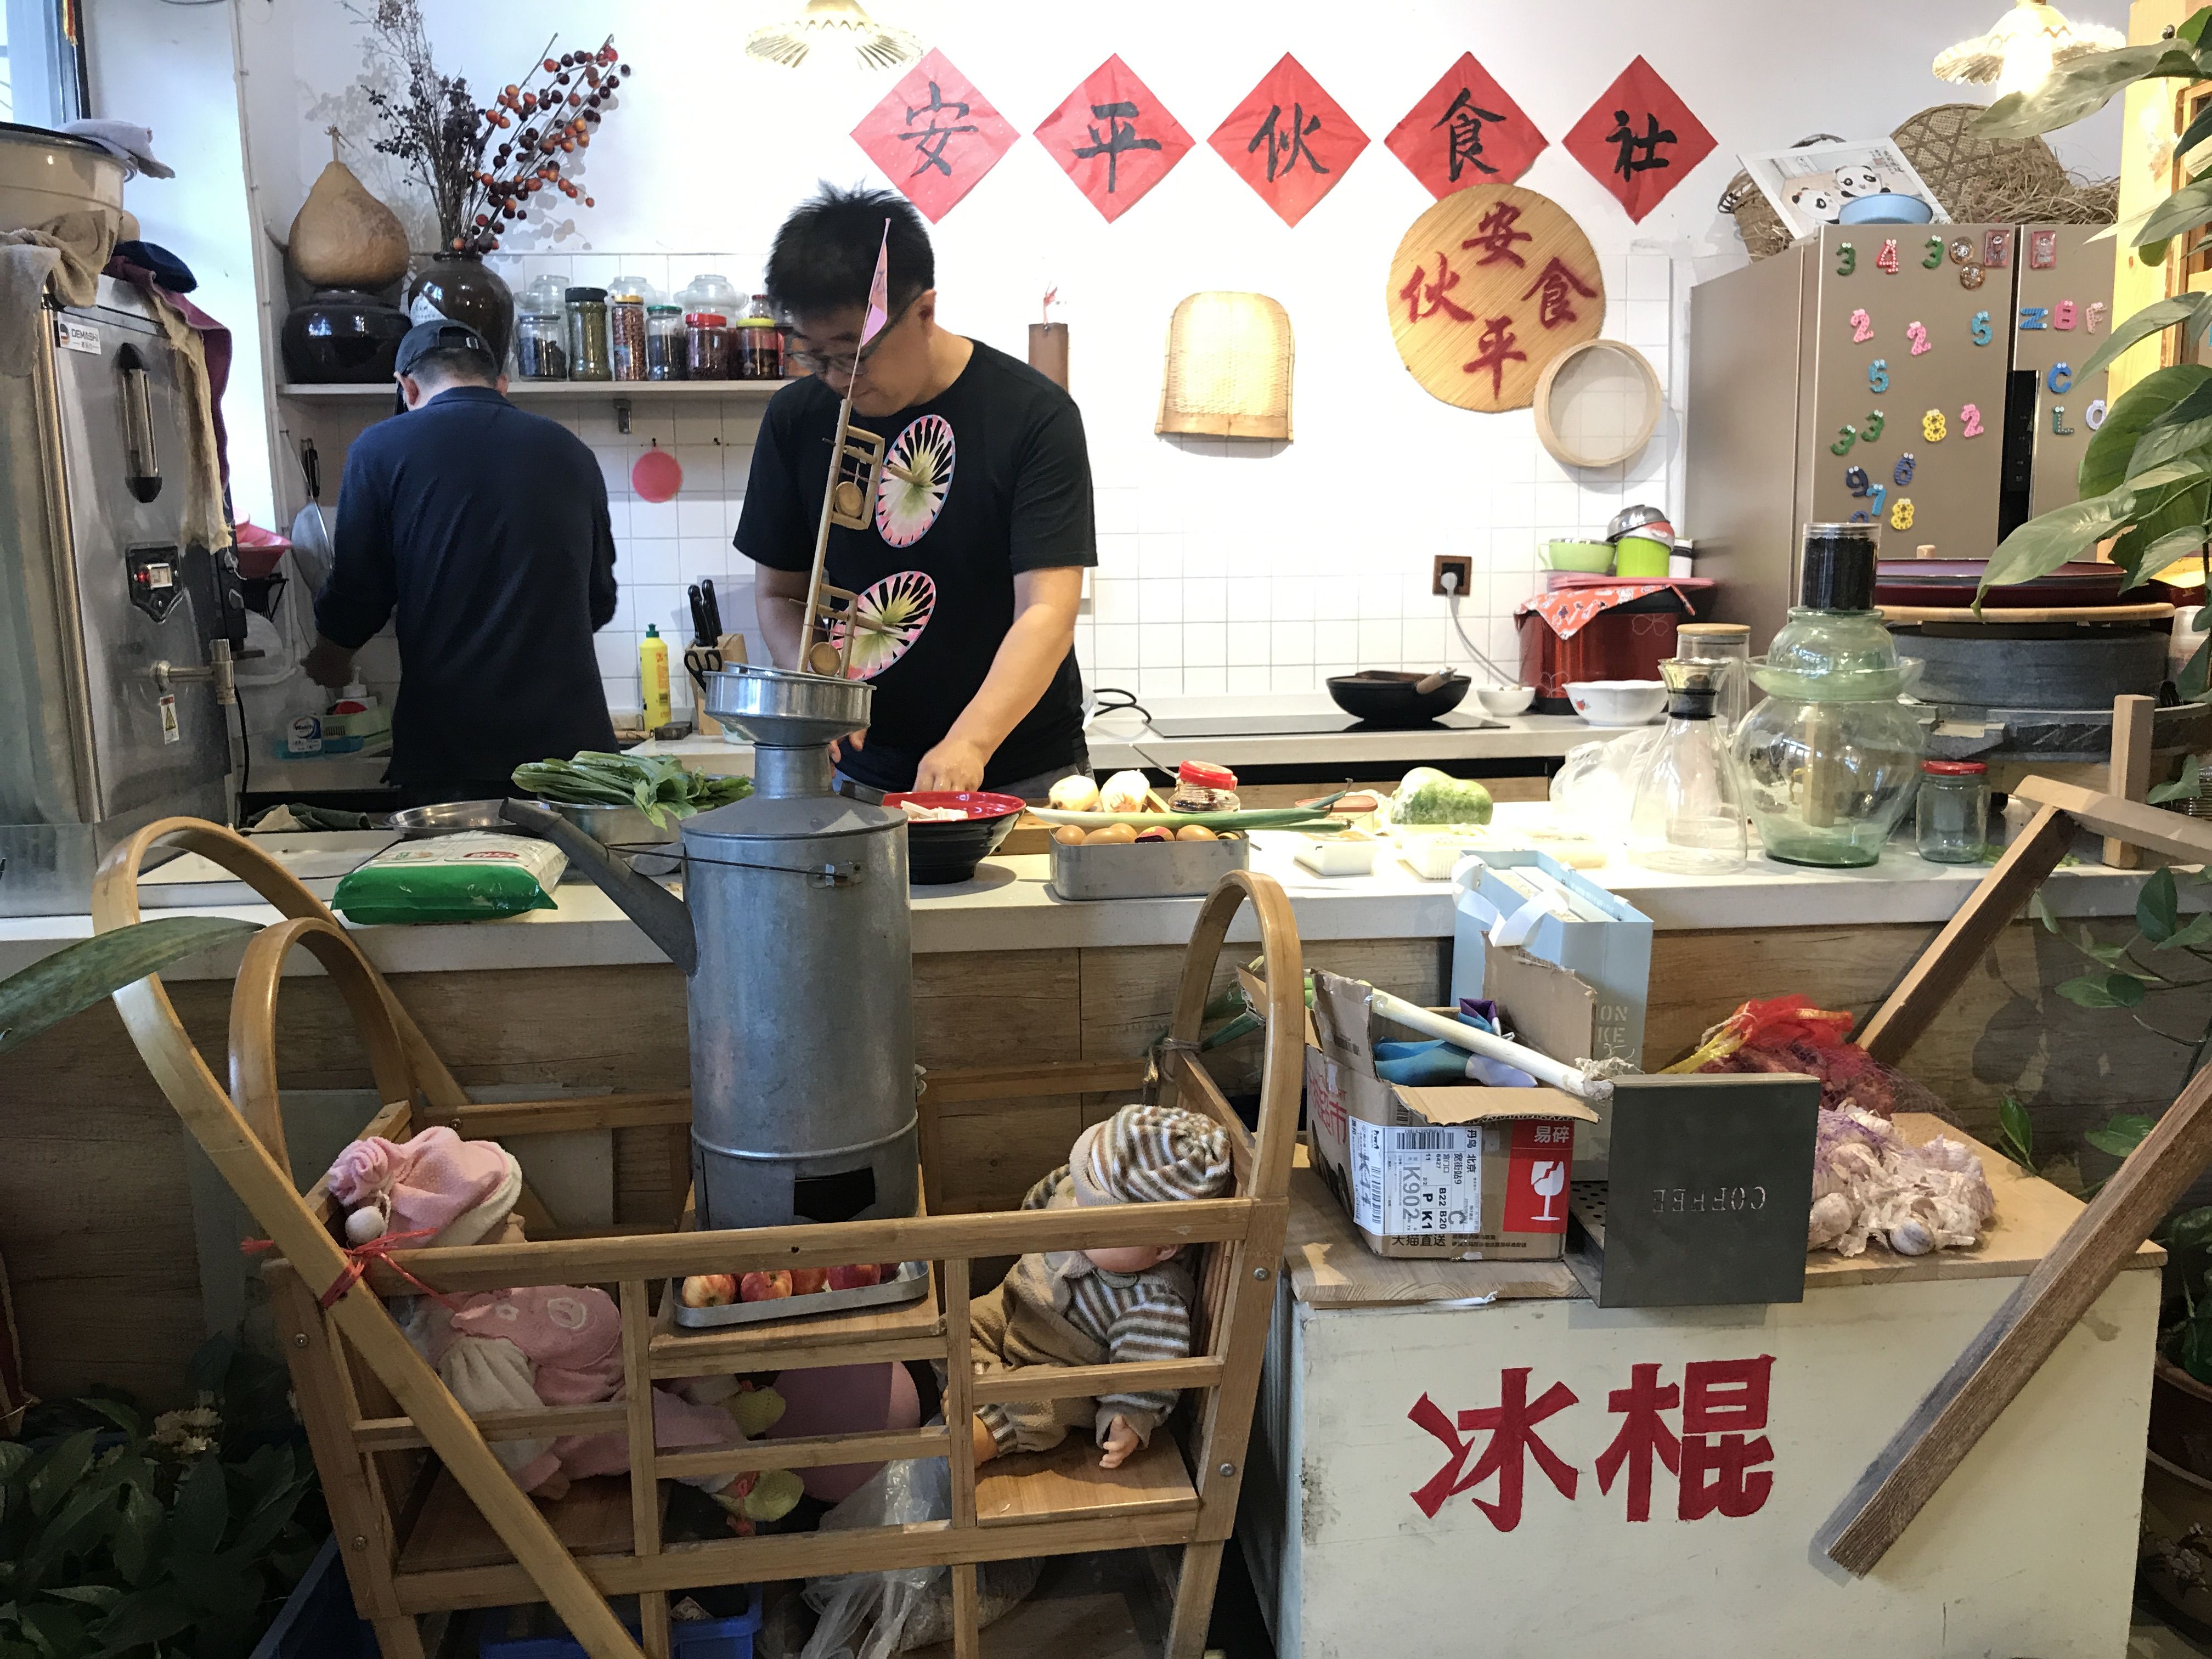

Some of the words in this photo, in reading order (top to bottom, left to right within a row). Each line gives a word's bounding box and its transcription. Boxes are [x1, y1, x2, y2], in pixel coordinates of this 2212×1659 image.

[1837, 242, 1856, 275] 3
[1876, 239, 1899, 274] 4
[1922, 235, 1944, 268] 3
[1850, 309, 1874, 343] 2
[1906, 321, 1931, 356] 2
[1971, 311, 1993, 346] 5
[2054, 300, 2078, 330] B
[2085, 302, 2107, 334] F
[1868, 359, 1889, 393] 5
[2047, 362, 2072, 393] C
[1830, 425, 1855, 455] 3
[1860, 409, 1885, 442] 3
[1922, 409, 1946, 442] 8
[1961, 404, 1984, 438] 2
[2052, 406, 2074, 435] L
[1846, 466, 1869, 496] 9
[1893, 453, 1915, 486] 6
[1866, 483, 1887, 516] 7
[1891, 498, 1915, 531] 8
[1466, 1130, 1477, 1148] 丹鸟
[1534, 1126, 1570, 1143] 易碎
[1466, 1154, 1477, 1173] 北京
[1403, 1167, 1420, 1220] K902
[1423, 1193, 1433, 1203] P
[1652, 1186, 1766, 1213] COFFEE
[1422, 1211, 1432, 1229] K1
[1407, 1353, 1776, 1532] 冰棍
